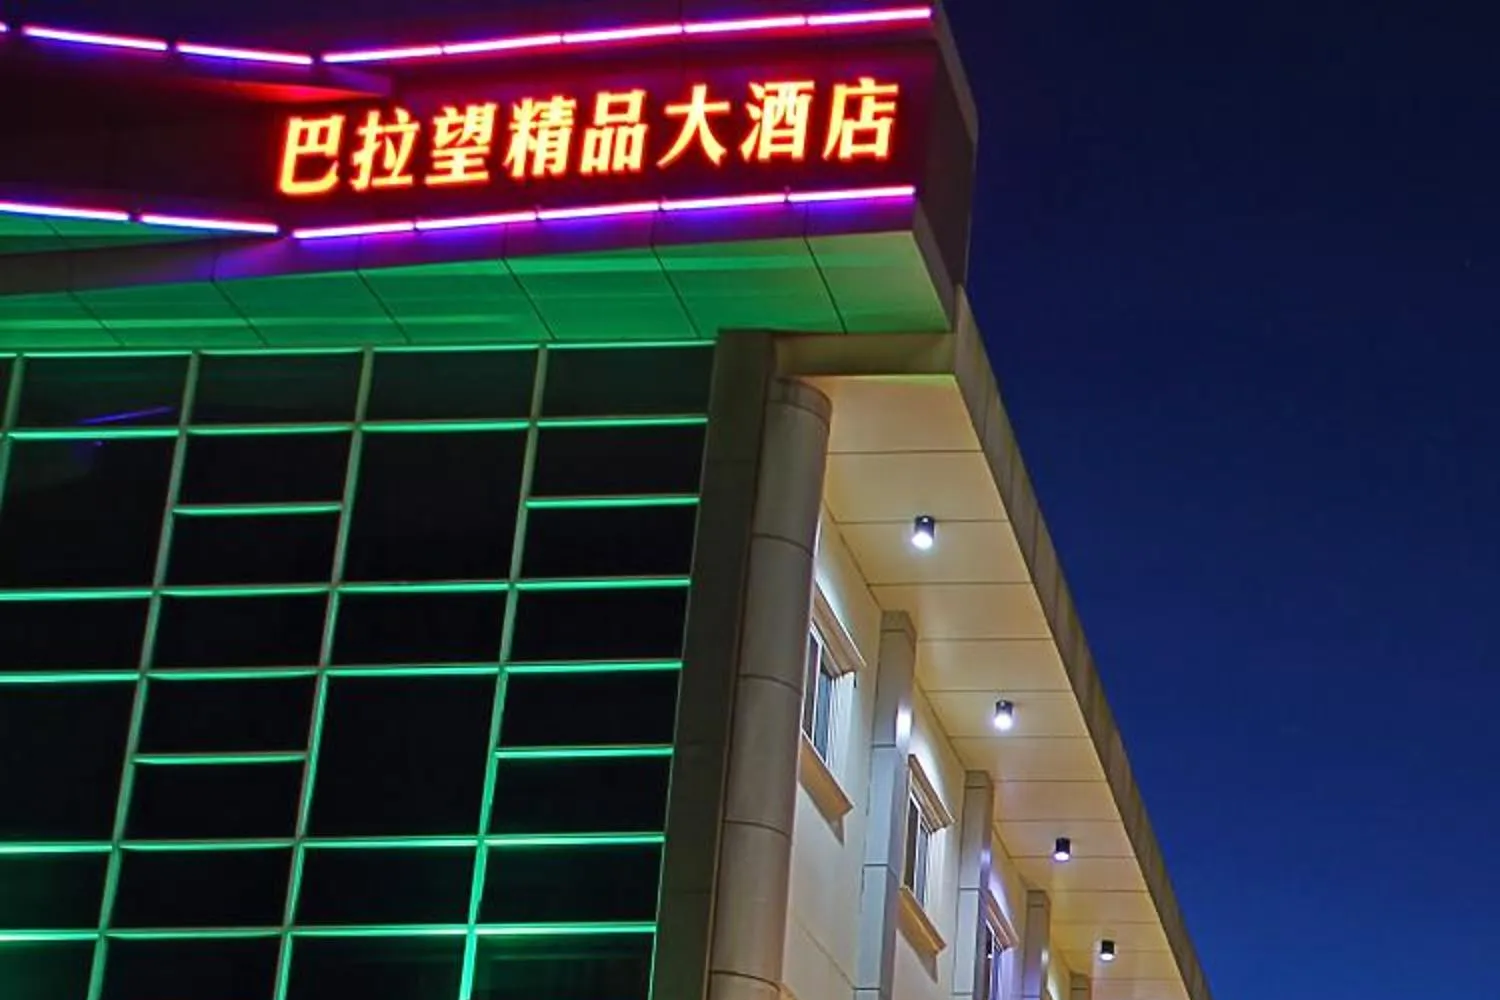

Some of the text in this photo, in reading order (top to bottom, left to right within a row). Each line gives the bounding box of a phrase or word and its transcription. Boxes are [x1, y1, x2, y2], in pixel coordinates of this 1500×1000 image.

[278, 76, 900, 196] 巴拉望精品大酒店
